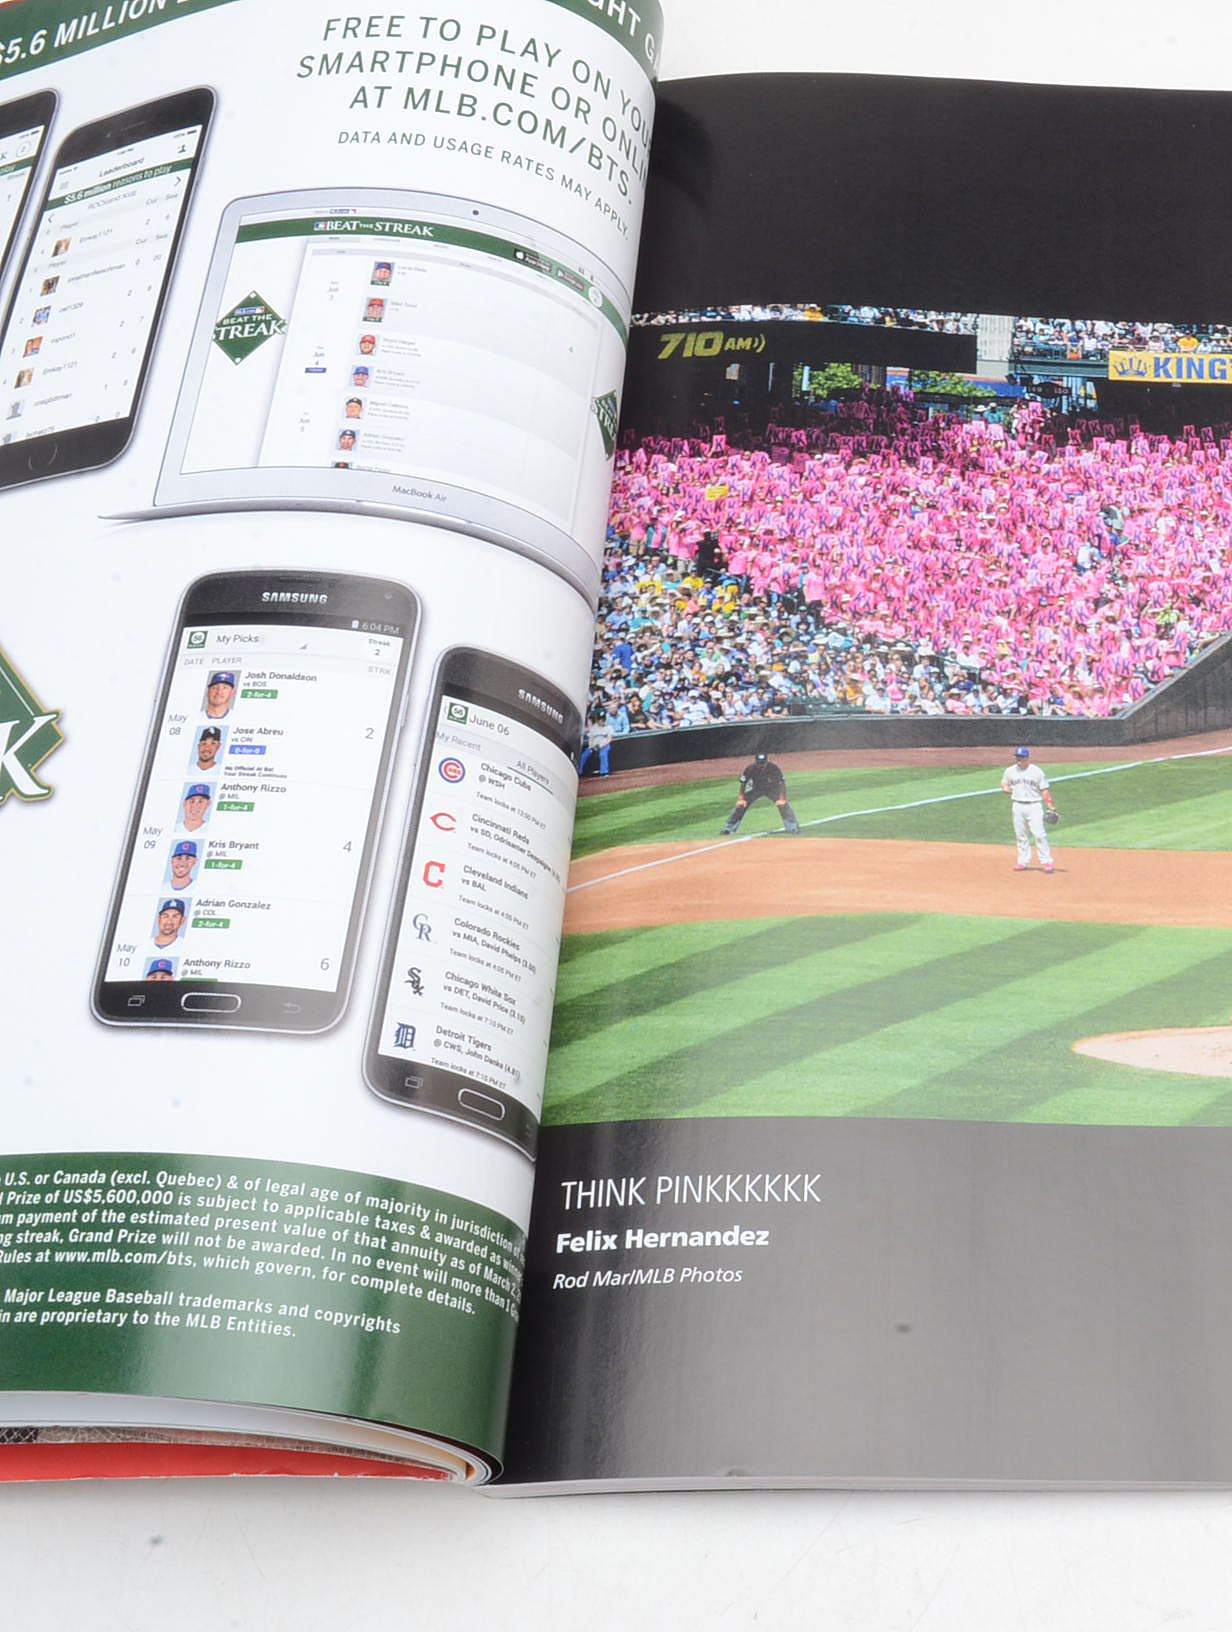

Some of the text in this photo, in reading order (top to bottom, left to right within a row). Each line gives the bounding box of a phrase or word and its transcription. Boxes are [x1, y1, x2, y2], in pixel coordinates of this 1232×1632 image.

[323, 15, 405, 41] FREE
[419, 16, 461, 41] TO
[476, 24, 561, 68] PLAY
[572, 59, 611, 100] ON
[297, 50, 539, 99] SMARTPHONE
[551, 86, 592, 124] OR
[349, 86, 633, 206] AT MLB.COM/BTS.
[338, 131, 629, 241] DATA AND USAGE RATES MAY APPLY.
[326, 221, 434, 237] BEAT STREAK
[223, 313, 272, 326] BEAT THE
[657, 331, 753, 359] 710 AM
[392, 485, 447, 502] MacBook Air
[262, 592, 328, 604] SAMSUNG
[216, 634, 259, 645] My Picks
[245, 671, 317, 682] Josh Donaldson
[518, 689, 563, 724] SAMSUNG
[232, 727, 284, 736] Jose Abreu
[365, 728, 375, 739] 2
[469, 715, 510, 735] June 06
[451, 735, 481, 751] Recent
[481, 763, 512, 781] Chicago
[221, 784, 287, 794] Anthony Rizzo
[472, 813, 511, 835] Cincinnati
[208, 841, 259, 850] Kris Bryant
[343, 841, 352, 852] 4
[463, 865, 502, 886] Cleveland
[196, 899, 271, 910] Adrian Gonzalez
[454, 917, 491, 937] Colorado
[118, 958, 130, 967] 10
[184, 958, 250, 969] Anthony Rizzo
[320, 959, 329, 970] 6
[445, 971, 479, 989] Chicago
[481, 983, 502, 999] White
[435, 1025, 492, 1052] Detroit Tigers
[561, 1174, 821, 1210] THINK PINKKKKKK
[4, 1170, 513, 1253] U.S. or Canada (excl. Quebec) & of legal age of majority in jurisdiction
[6, 1188, 501, 1266] Prize of US$5,600,000 is subject to applicable taxes & awarded as
[556, 1225, 769, 1253] Felix Hernandez
[16, 1209, 510, 1293] payment of the estimated present value of that annuity as of March
[15, 1229, 505, 1309] streak, Grand Prize will not be awarded. In no event will more than
[553, 1271, 589, 1289] Rod
[680, 1267, 743, 1283] Photos
[35, 1249, 51, 1262] at
[54, 1248, 197, 1269] www.mlb.com/bts,
[203, 1254, 250, 1271] which
[322, 1265, 352, 1283] for
[351, 1271, 423, 1298] complete
[427, 1288, 476, 1315] details.
[4, 1288, 401, 1334] Major League Baseball trademarks and copyrights
[14, 1309, 296, 1337] are proprietary to the MLB Entities.
